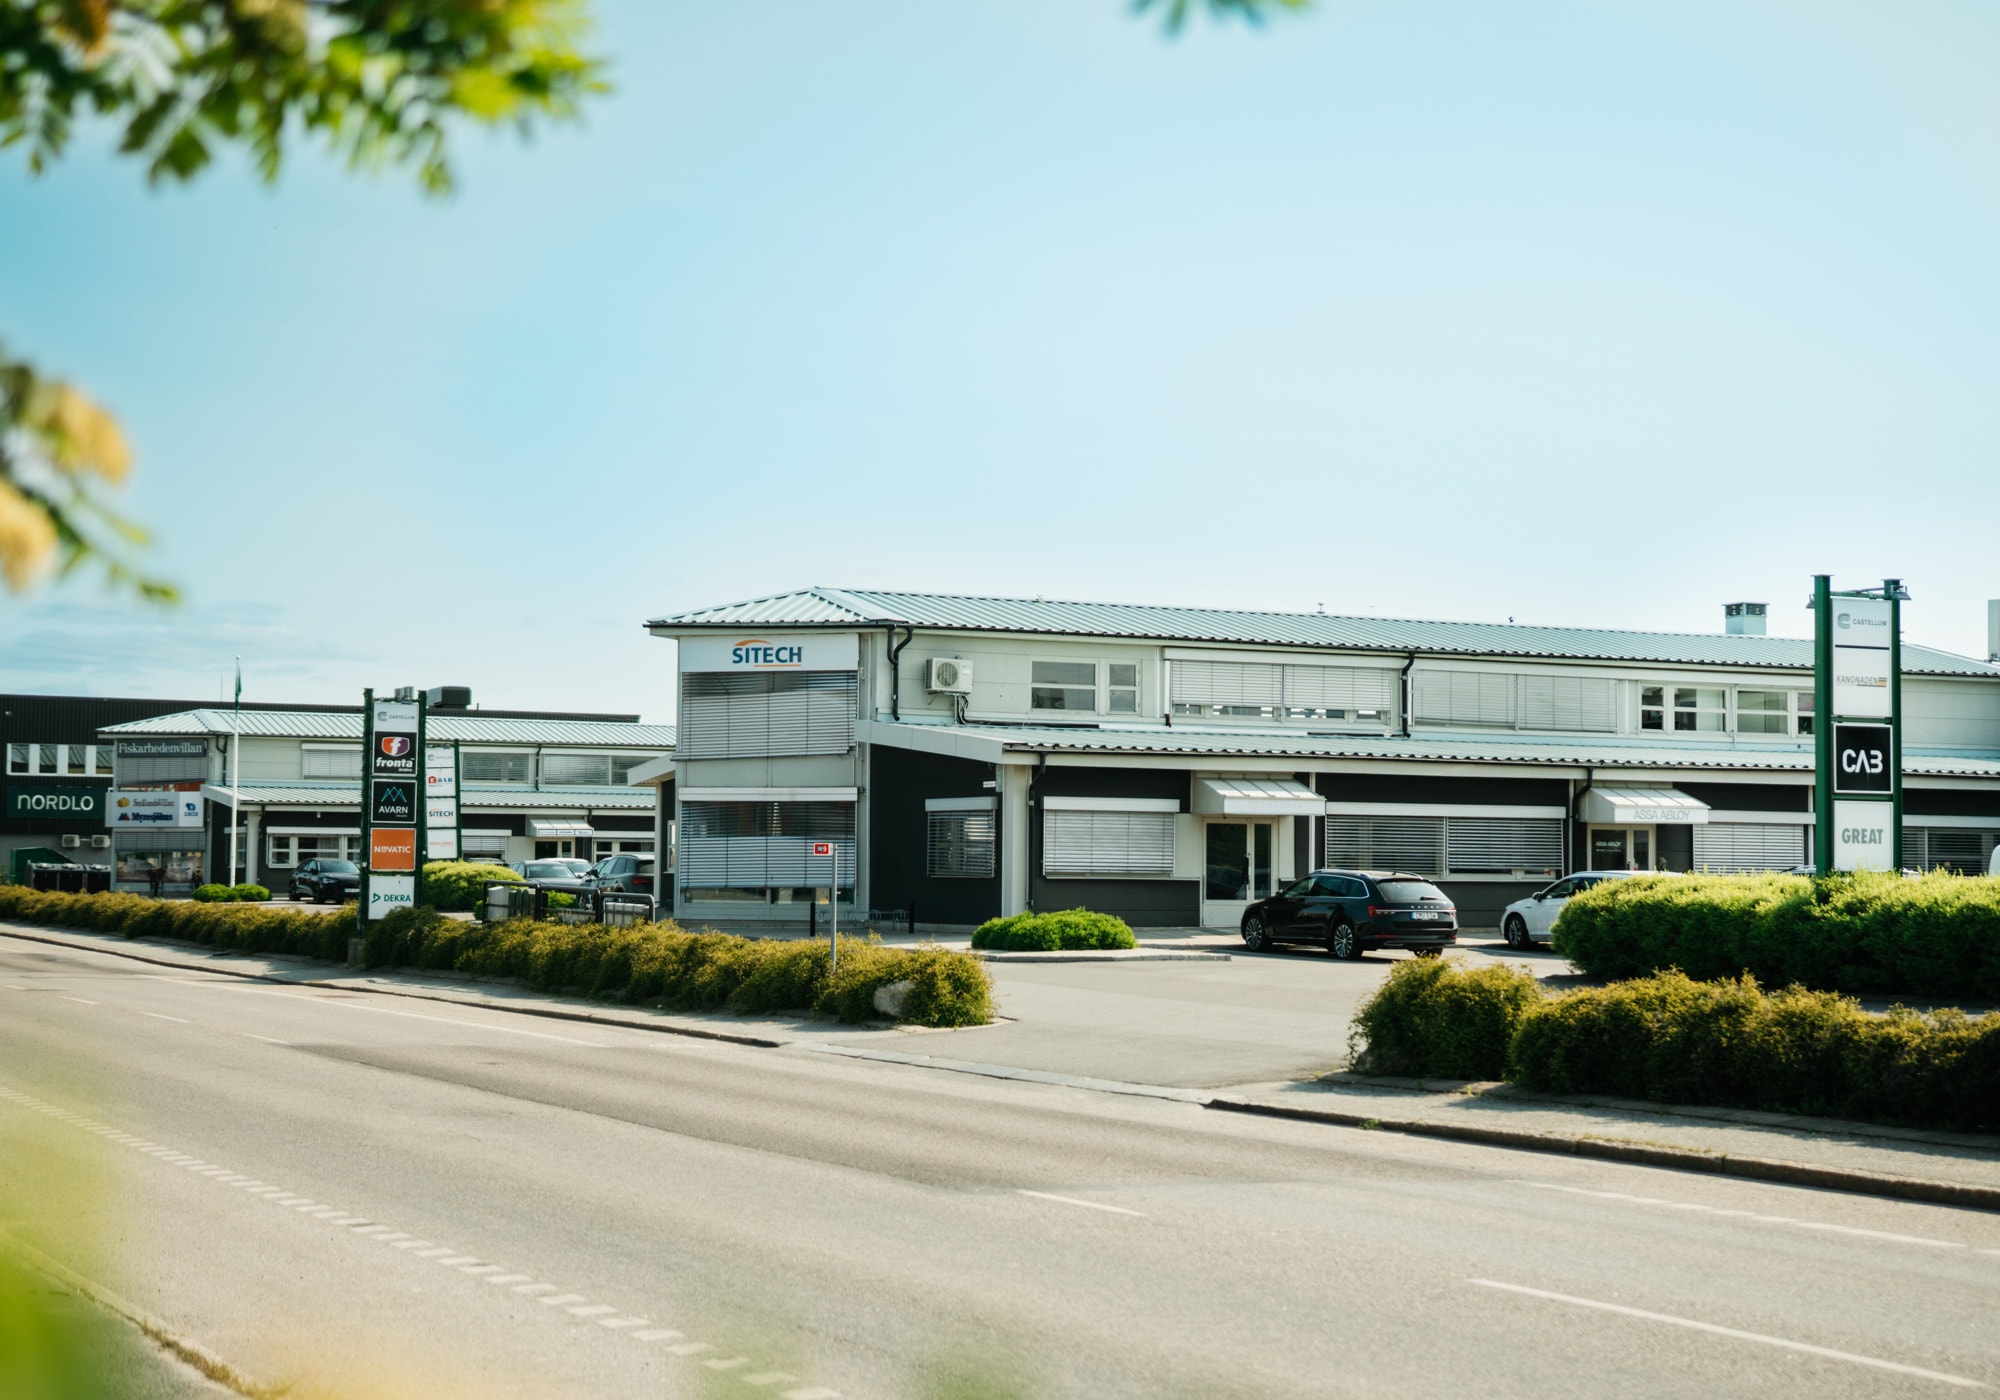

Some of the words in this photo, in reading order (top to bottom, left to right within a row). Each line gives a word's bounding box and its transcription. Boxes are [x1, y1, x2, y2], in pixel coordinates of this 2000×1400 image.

[1852, 618, 1888, 627] CASTELLUM
[732, 646, 802, 664] SITECH
[1836, 675, 1878, 685] KANONADEN
[118, 742, 203, 754] Fiskarhedenvillan
[376, 757, 413, 768] fronta
[379, 805, 409, 814] AVARN
[428, 810, 454, 818] SITECH
[1633, 809, 1658, 820] ASSA
[1659, 809, 1690, 820] ABLOY
[1842, 828, 1884, 845] GREAT
[374, 846, 411, 854] NOVATIC
[384, 894, 412, 903] DEKRA
